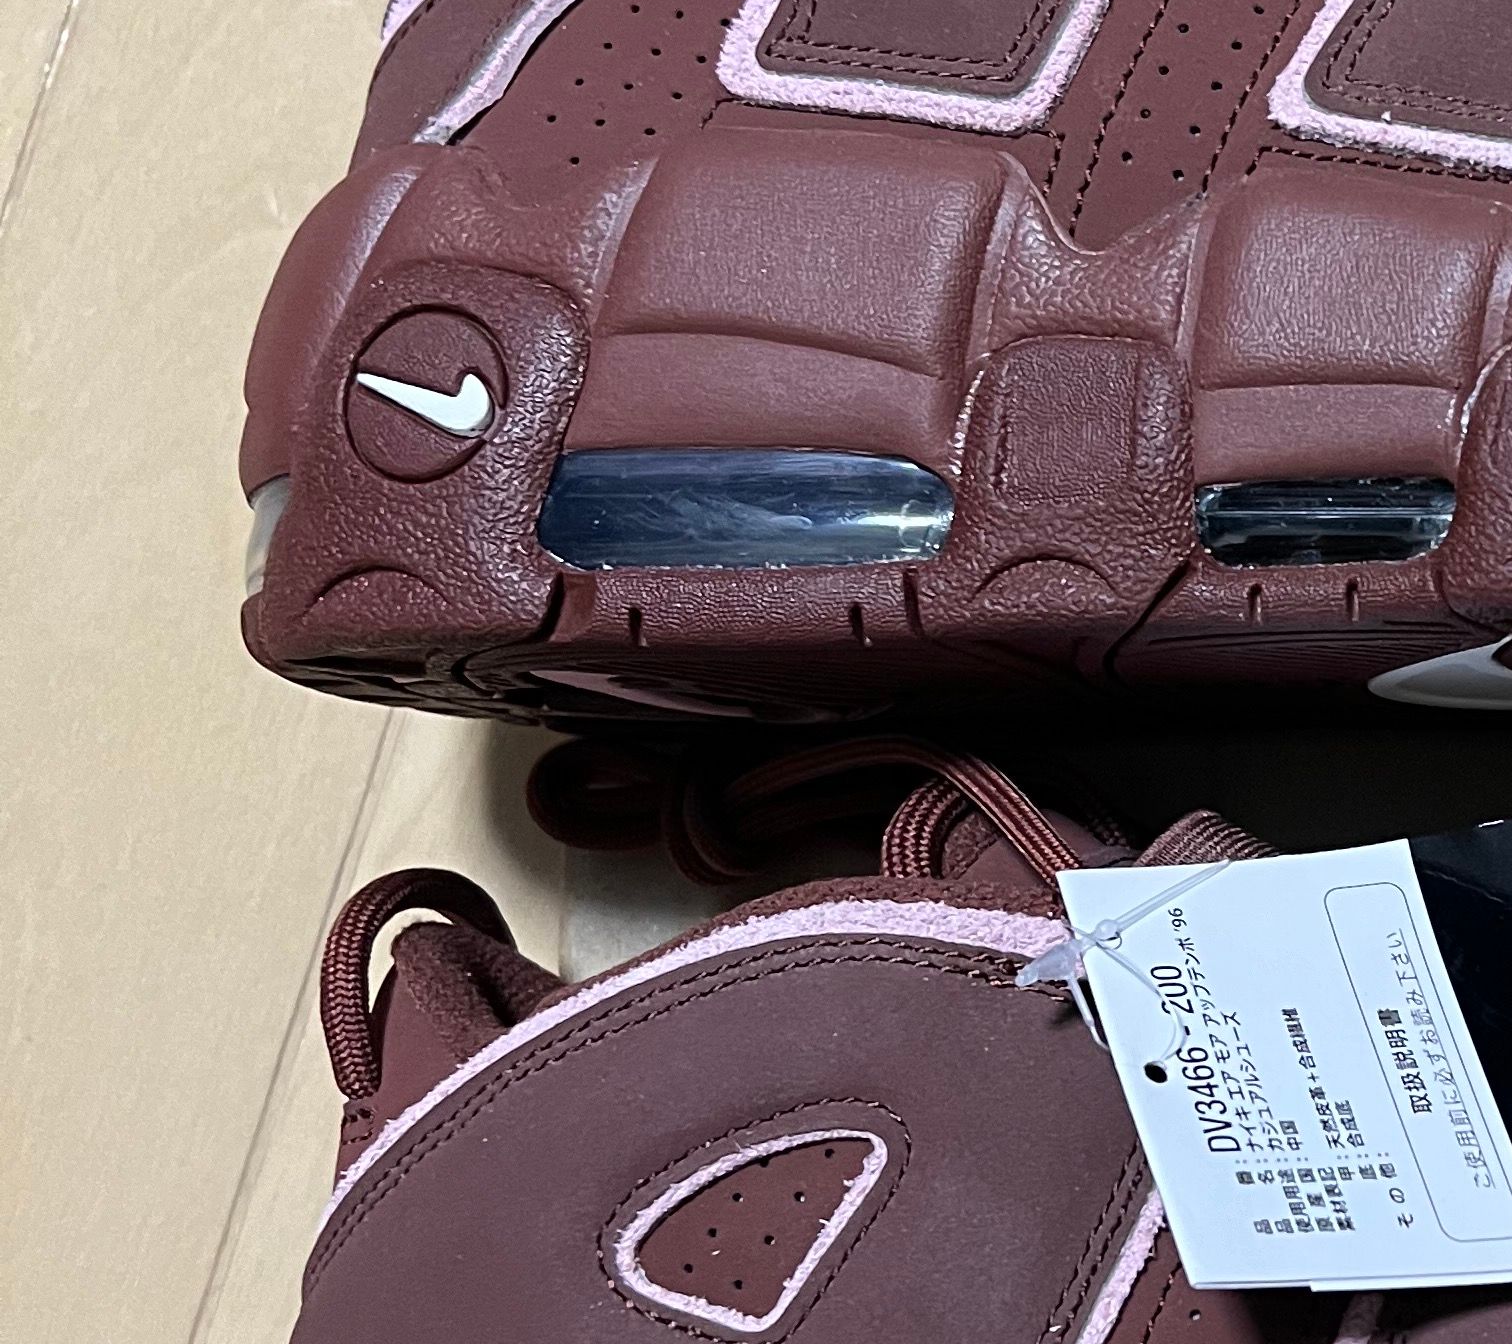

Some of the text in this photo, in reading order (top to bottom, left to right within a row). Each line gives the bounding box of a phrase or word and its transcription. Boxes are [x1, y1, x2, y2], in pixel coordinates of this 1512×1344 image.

[1150, 964, 1195, 1015] 200
[1177, 1047, 1242, 1153] DV3466
[1378, 1009, 1432, 1114] 取扱説明書
